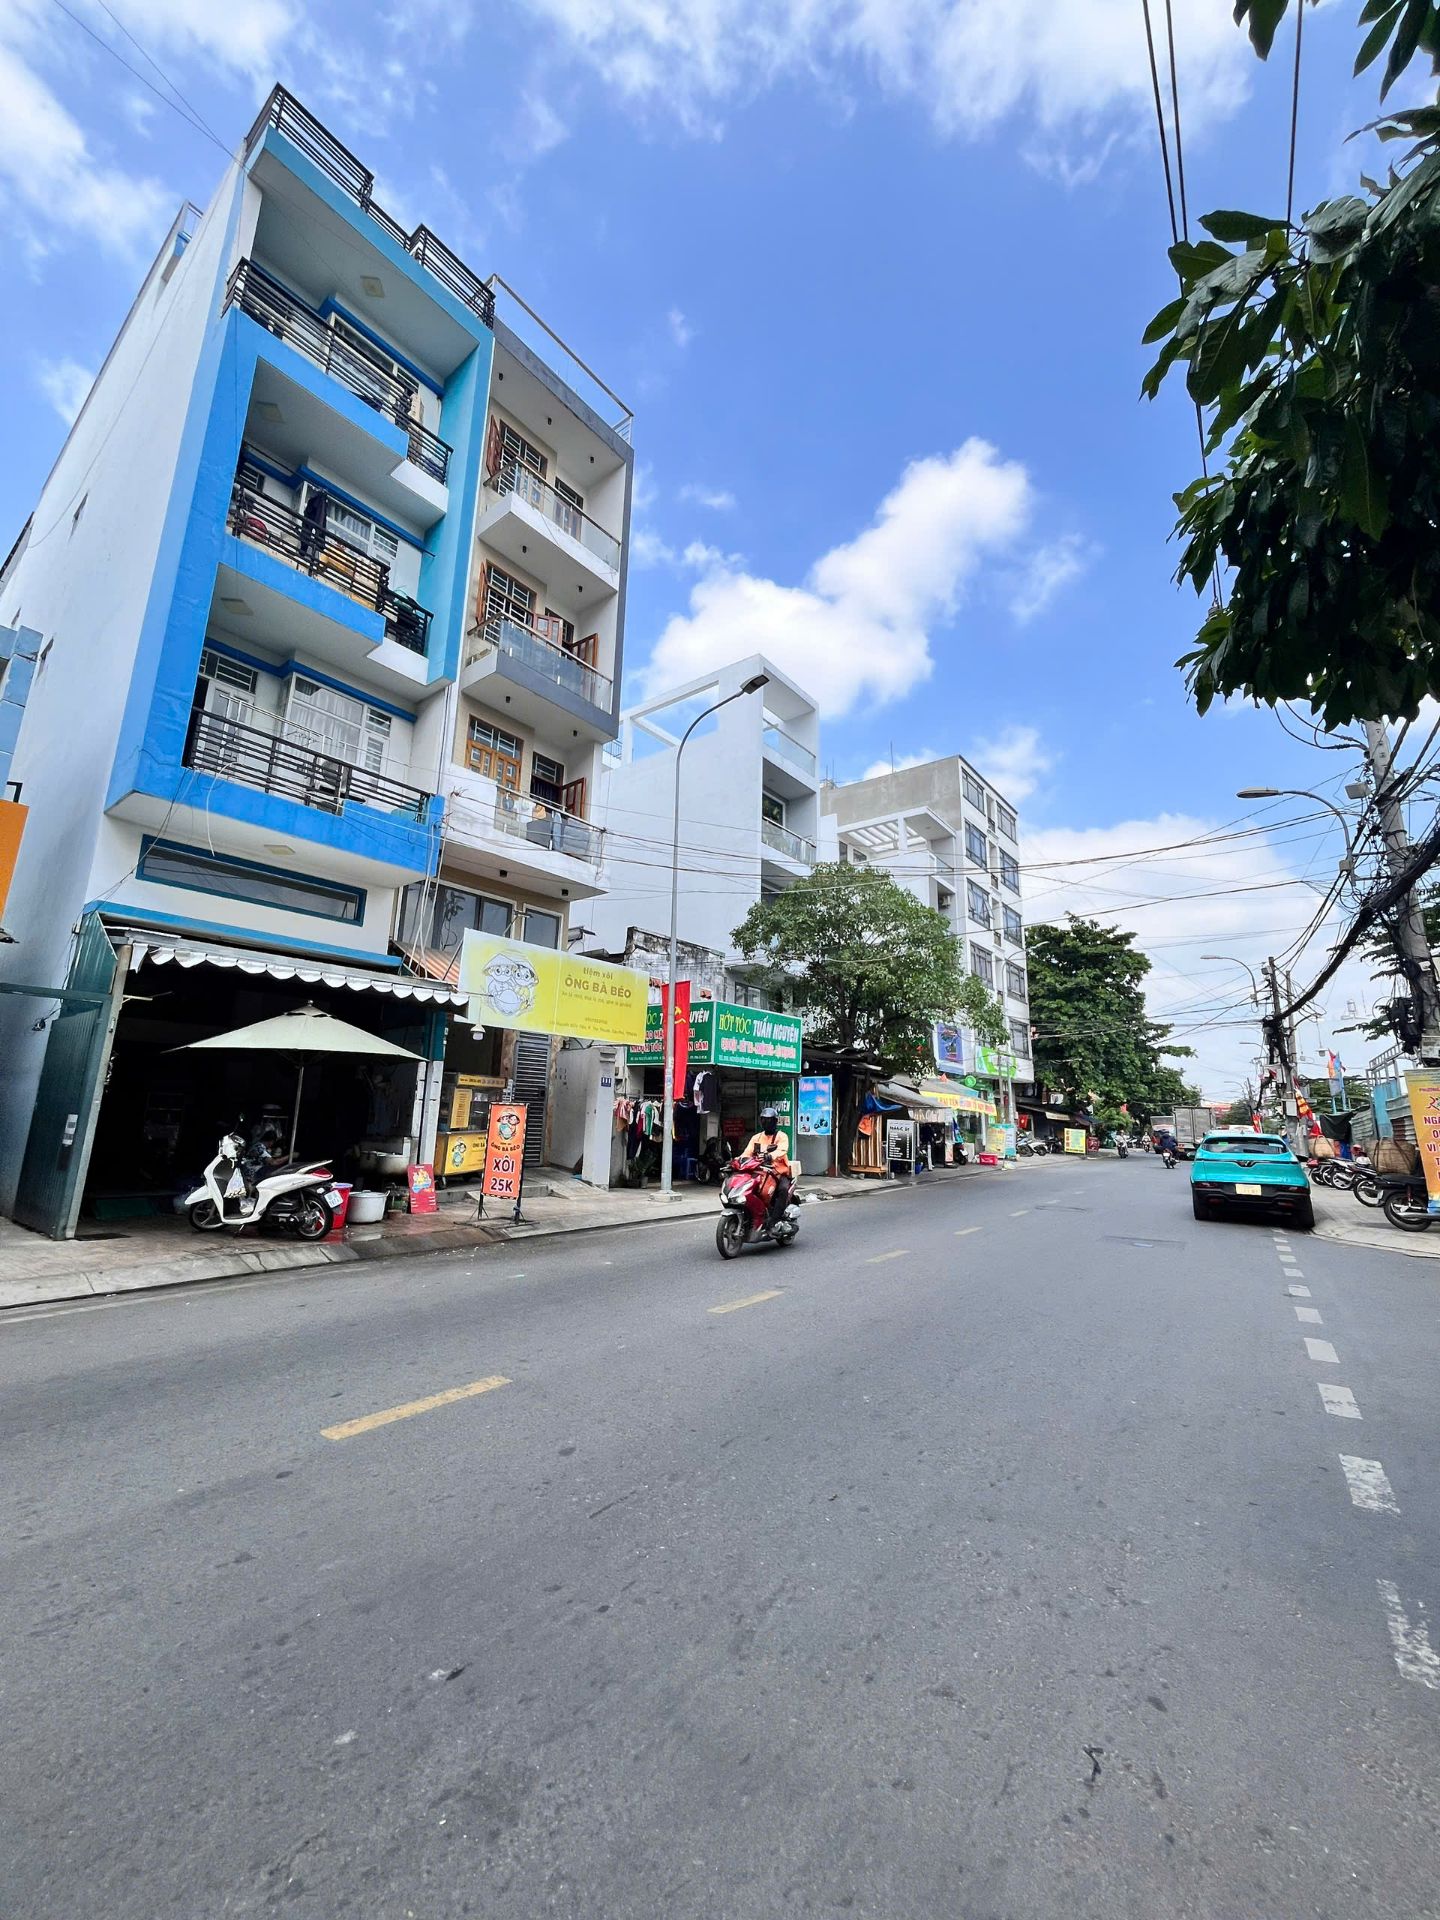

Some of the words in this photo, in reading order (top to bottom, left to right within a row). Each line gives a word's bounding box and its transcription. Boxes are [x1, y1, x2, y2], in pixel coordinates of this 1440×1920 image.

[565, 974, 589, 990] ÔNG
[592, 981, 607, 994] BÀ
[610, 985, 631, 998] BÉO
[646, 1009, 657, 1025] ÓC
[689, 1007, 710, 1023] UYÊN
[735, 1013, 752, 1035] TÓC
[753, 1015, 773, 1039] TUẤN
[772, 1023, 800, 1043] NGUYÊN
[493, 1154, 515, 1173] XÔI
[490, 1177, 513, 1193] 25K
